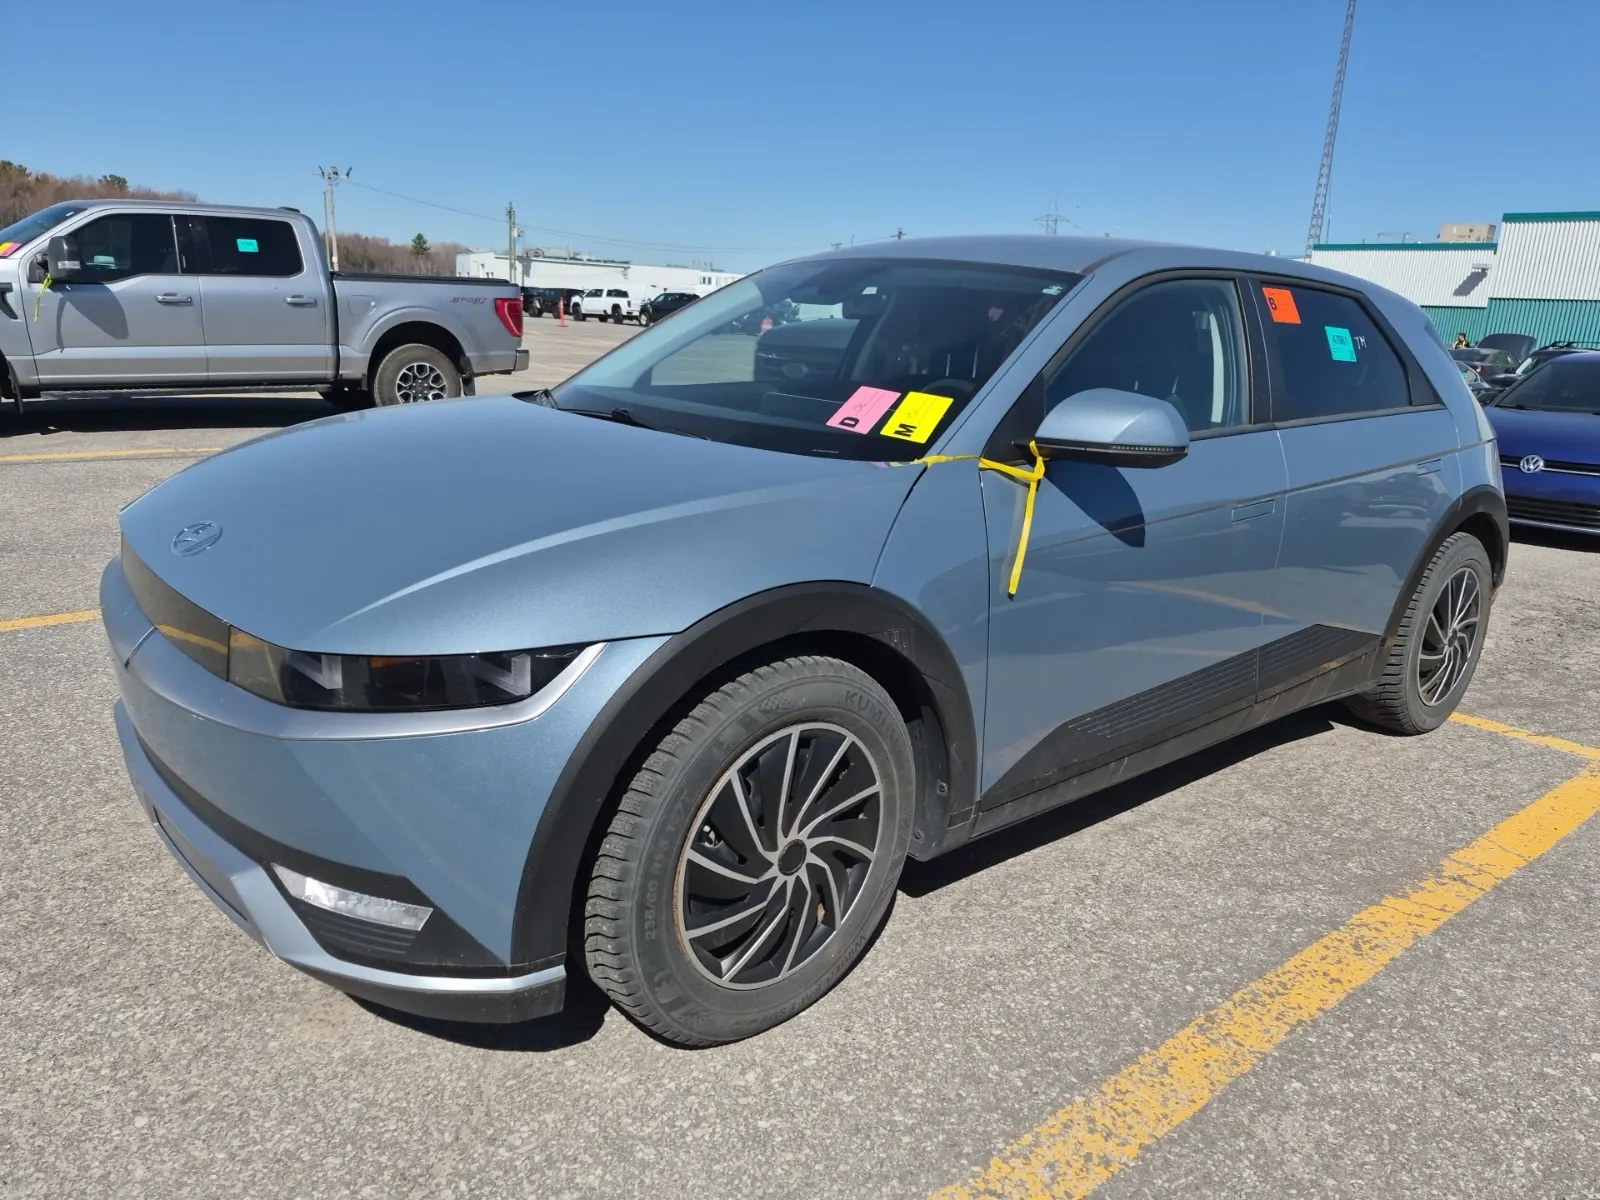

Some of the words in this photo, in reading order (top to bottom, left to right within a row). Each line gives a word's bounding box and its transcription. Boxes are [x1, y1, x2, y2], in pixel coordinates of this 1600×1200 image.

[1268, 297, 1277, 310] B
[838, 416, 860, 428] D
[894, 423, 917, 438] M
[844, 688, 899, 743] KUMHO
